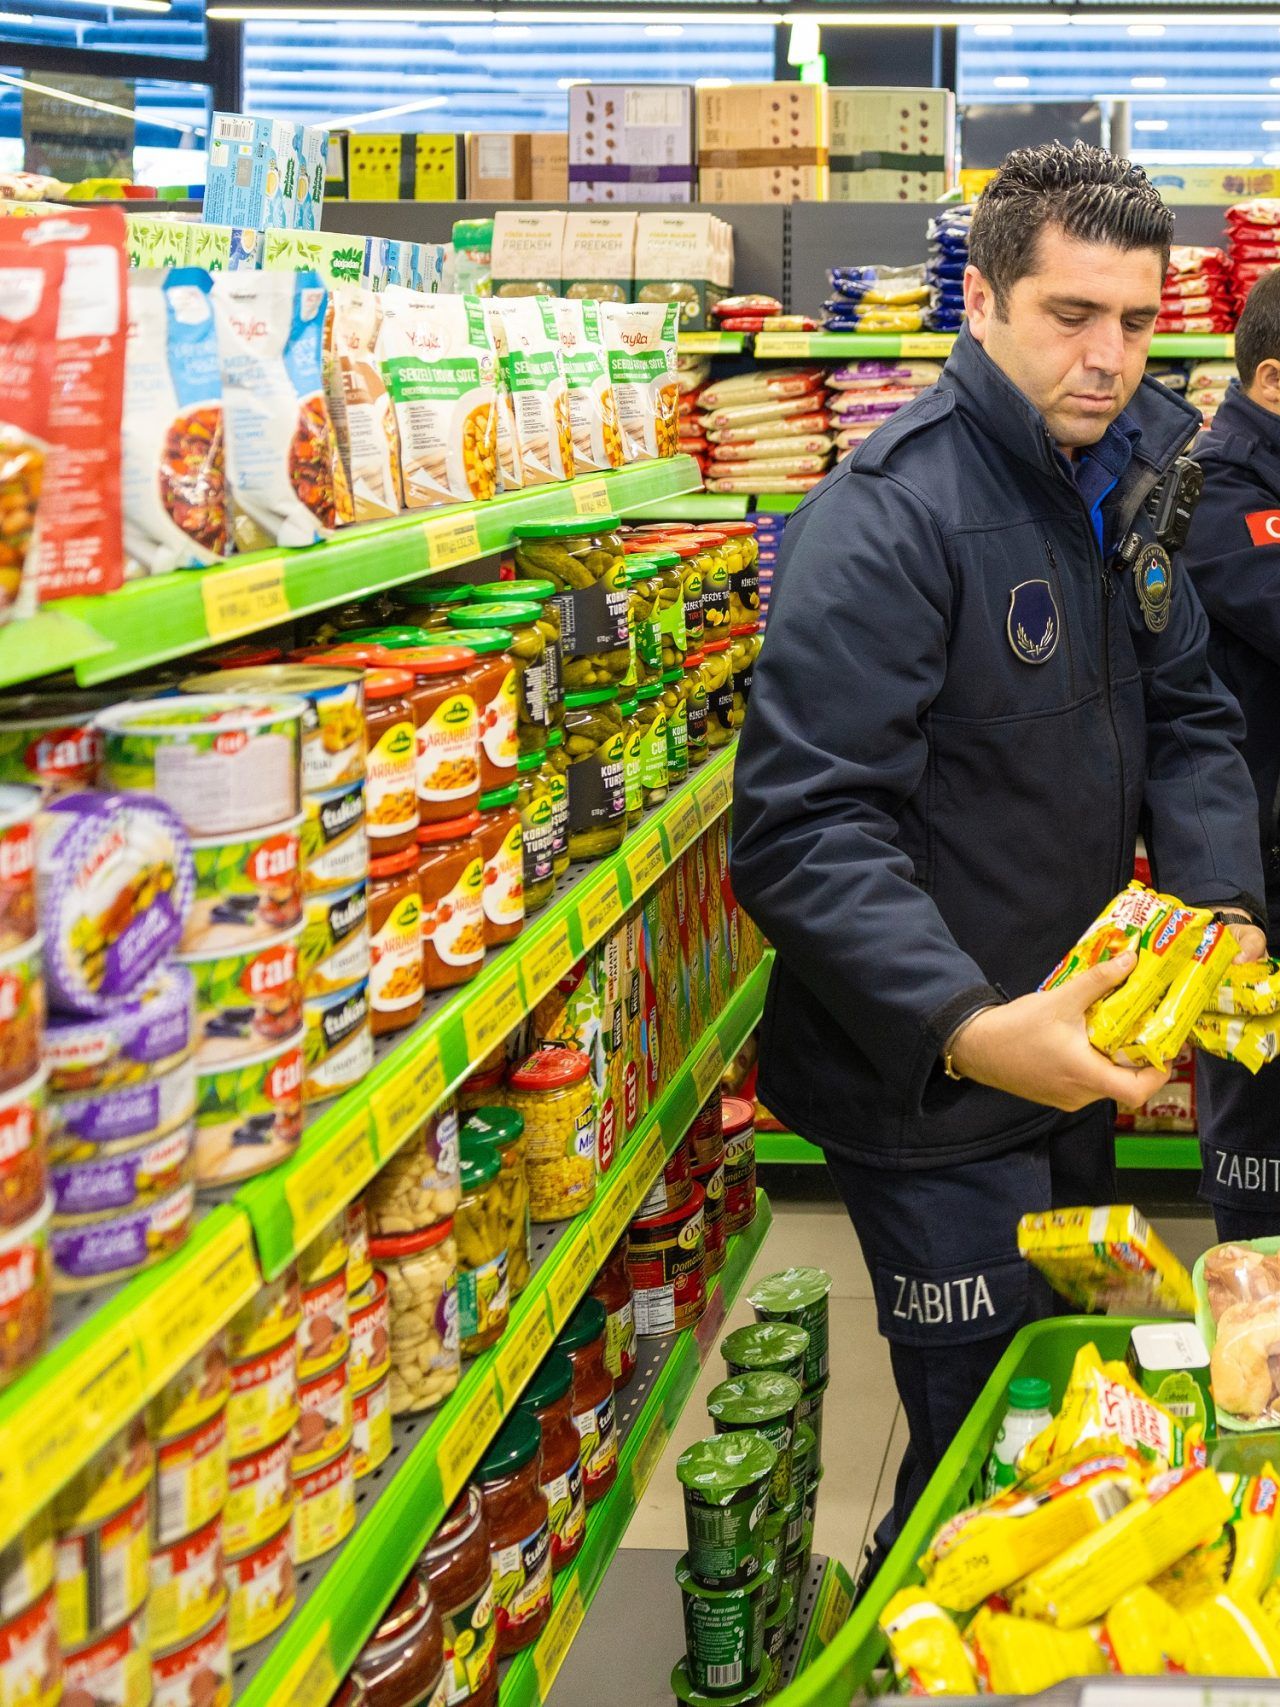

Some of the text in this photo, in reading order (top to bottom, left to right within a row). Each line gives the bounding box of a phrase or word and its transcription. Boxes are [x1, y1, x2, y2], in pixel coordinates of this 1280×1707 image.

[626, 1070, 637, 1125] tat
[601, 1103, 614, 1165] tat
[892, 1274, 996, 1323] ZABITA
